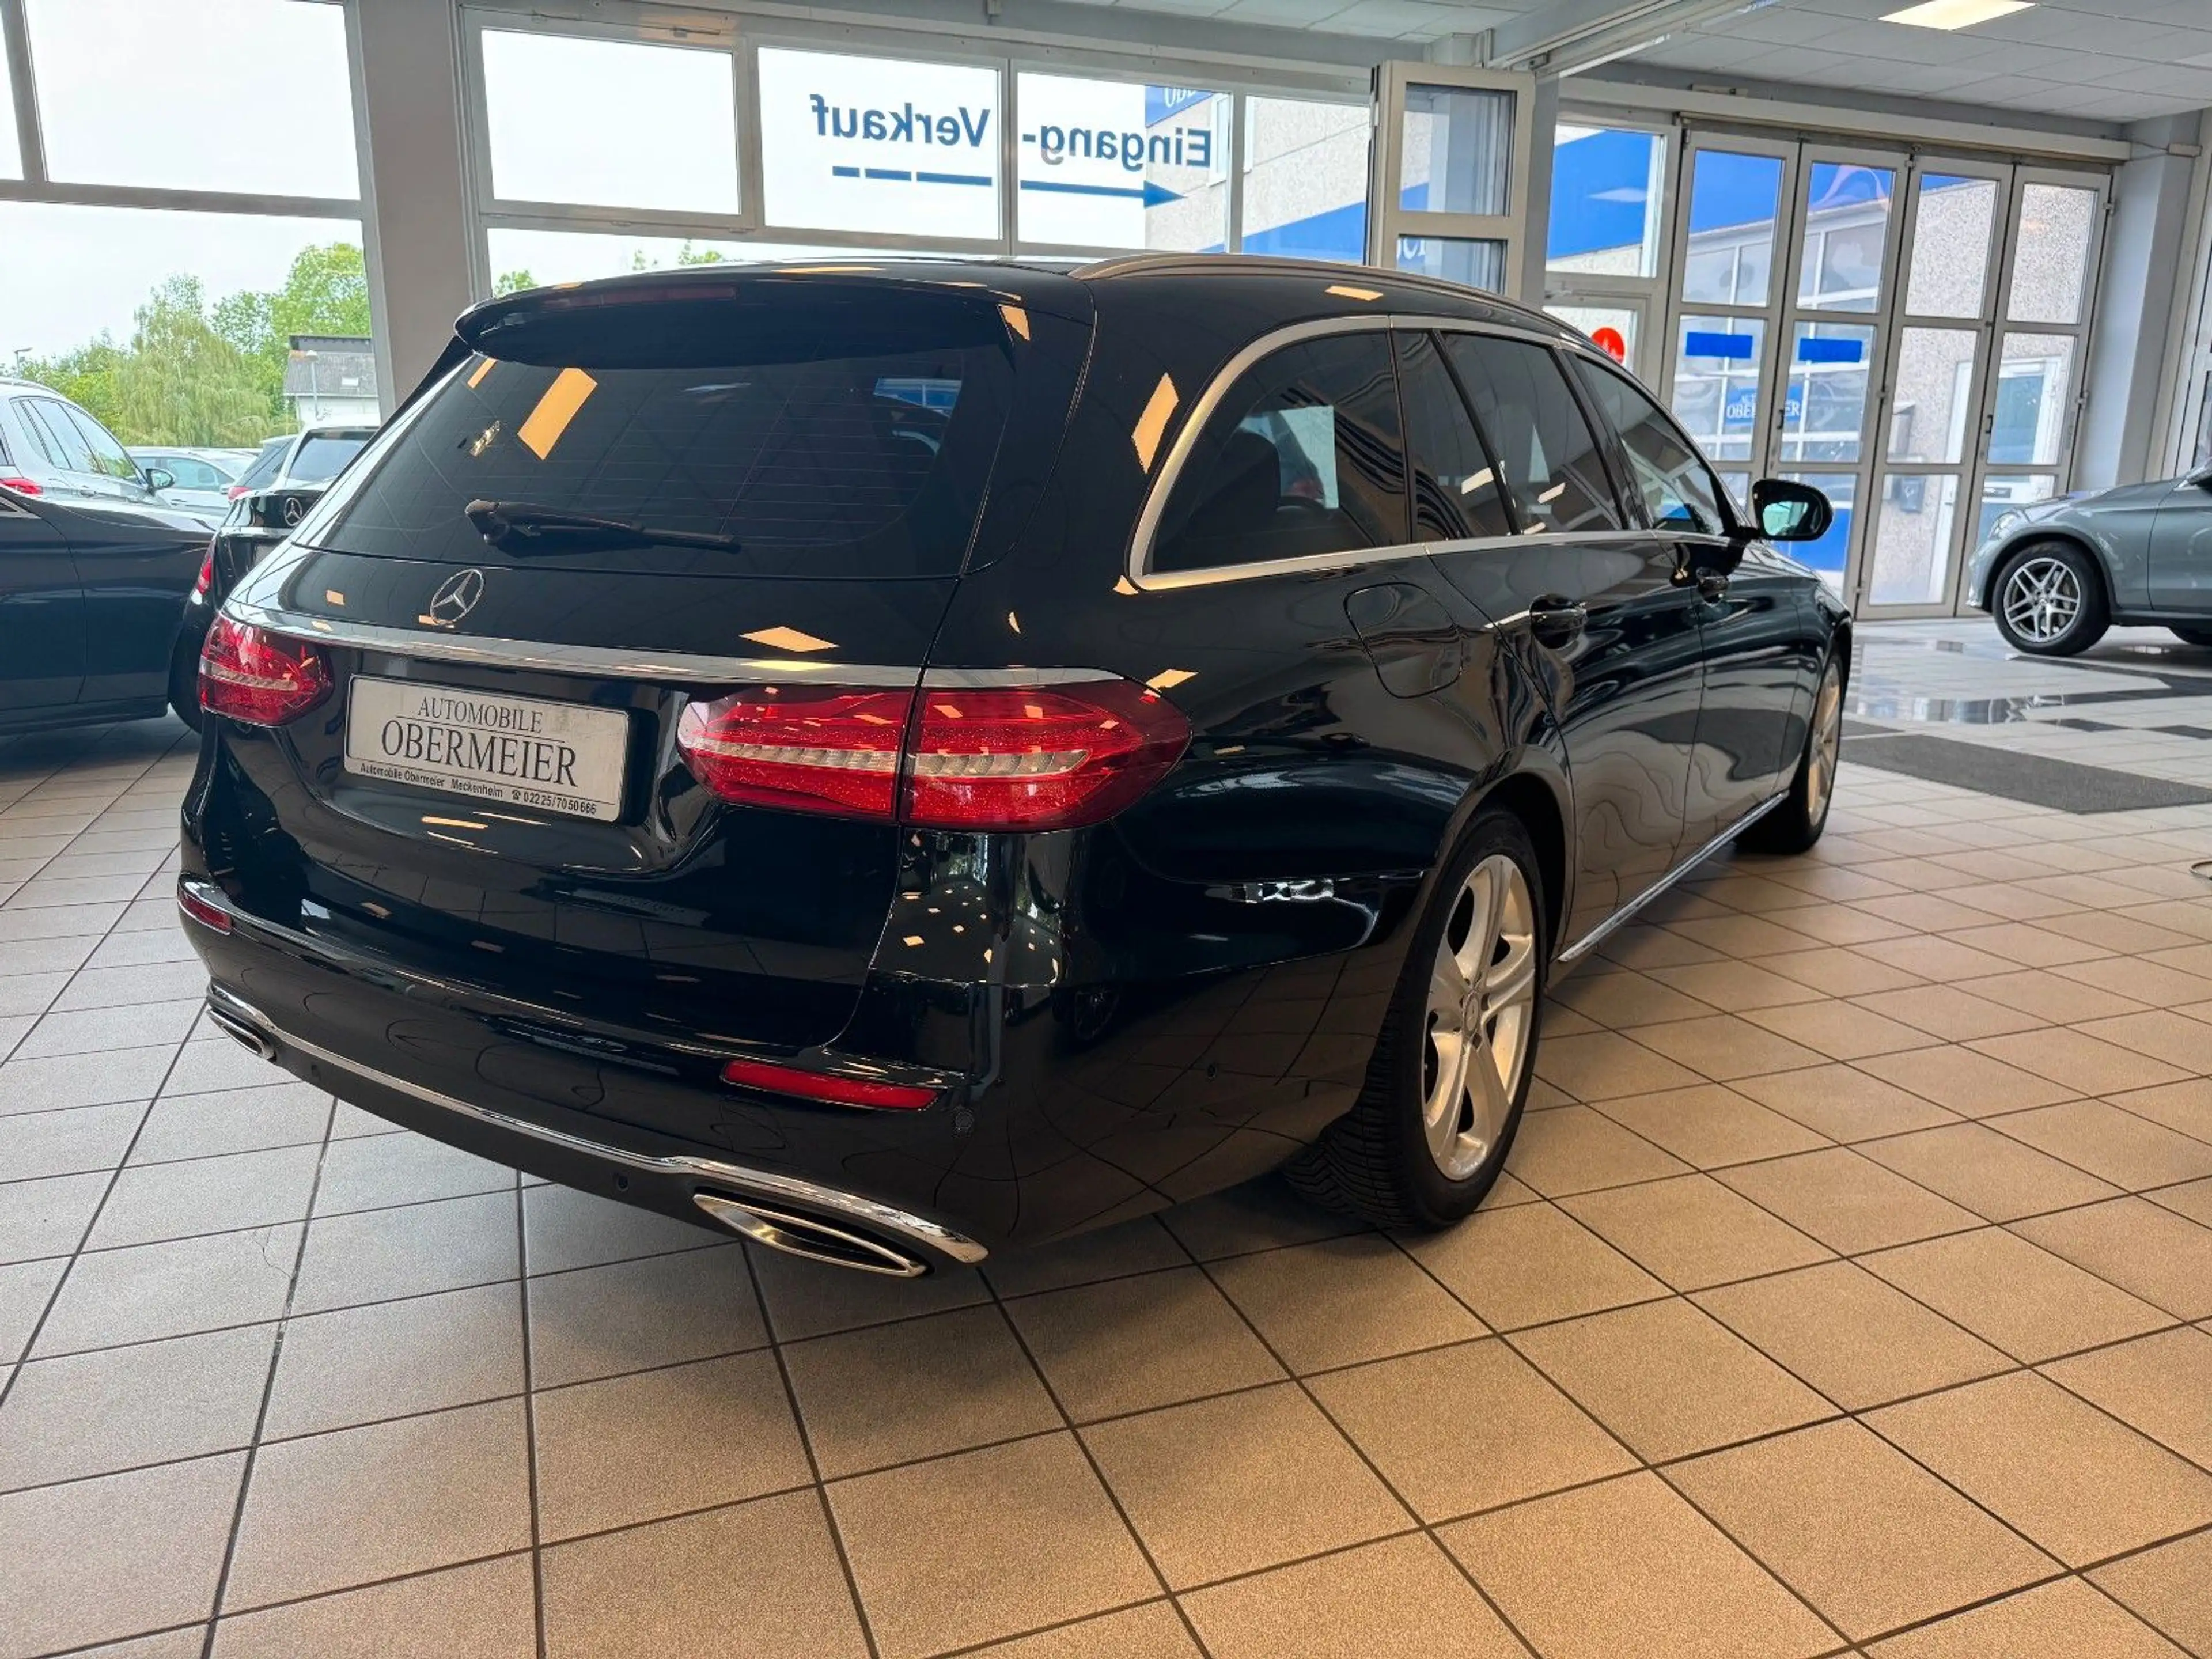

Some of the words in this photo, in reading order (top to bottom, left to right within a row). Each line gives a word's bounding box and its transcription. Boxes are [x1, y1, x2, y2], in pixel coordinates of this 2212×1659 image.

[418, 696, 543, 733] AUTOMOBILE
[381, 719, 578, 787] OBERMEIER
[361, 763, 402, 779] Automobile
[404, 770, 445, 786] Obermeier
[451, 778, 503, 798] Meckenheim
